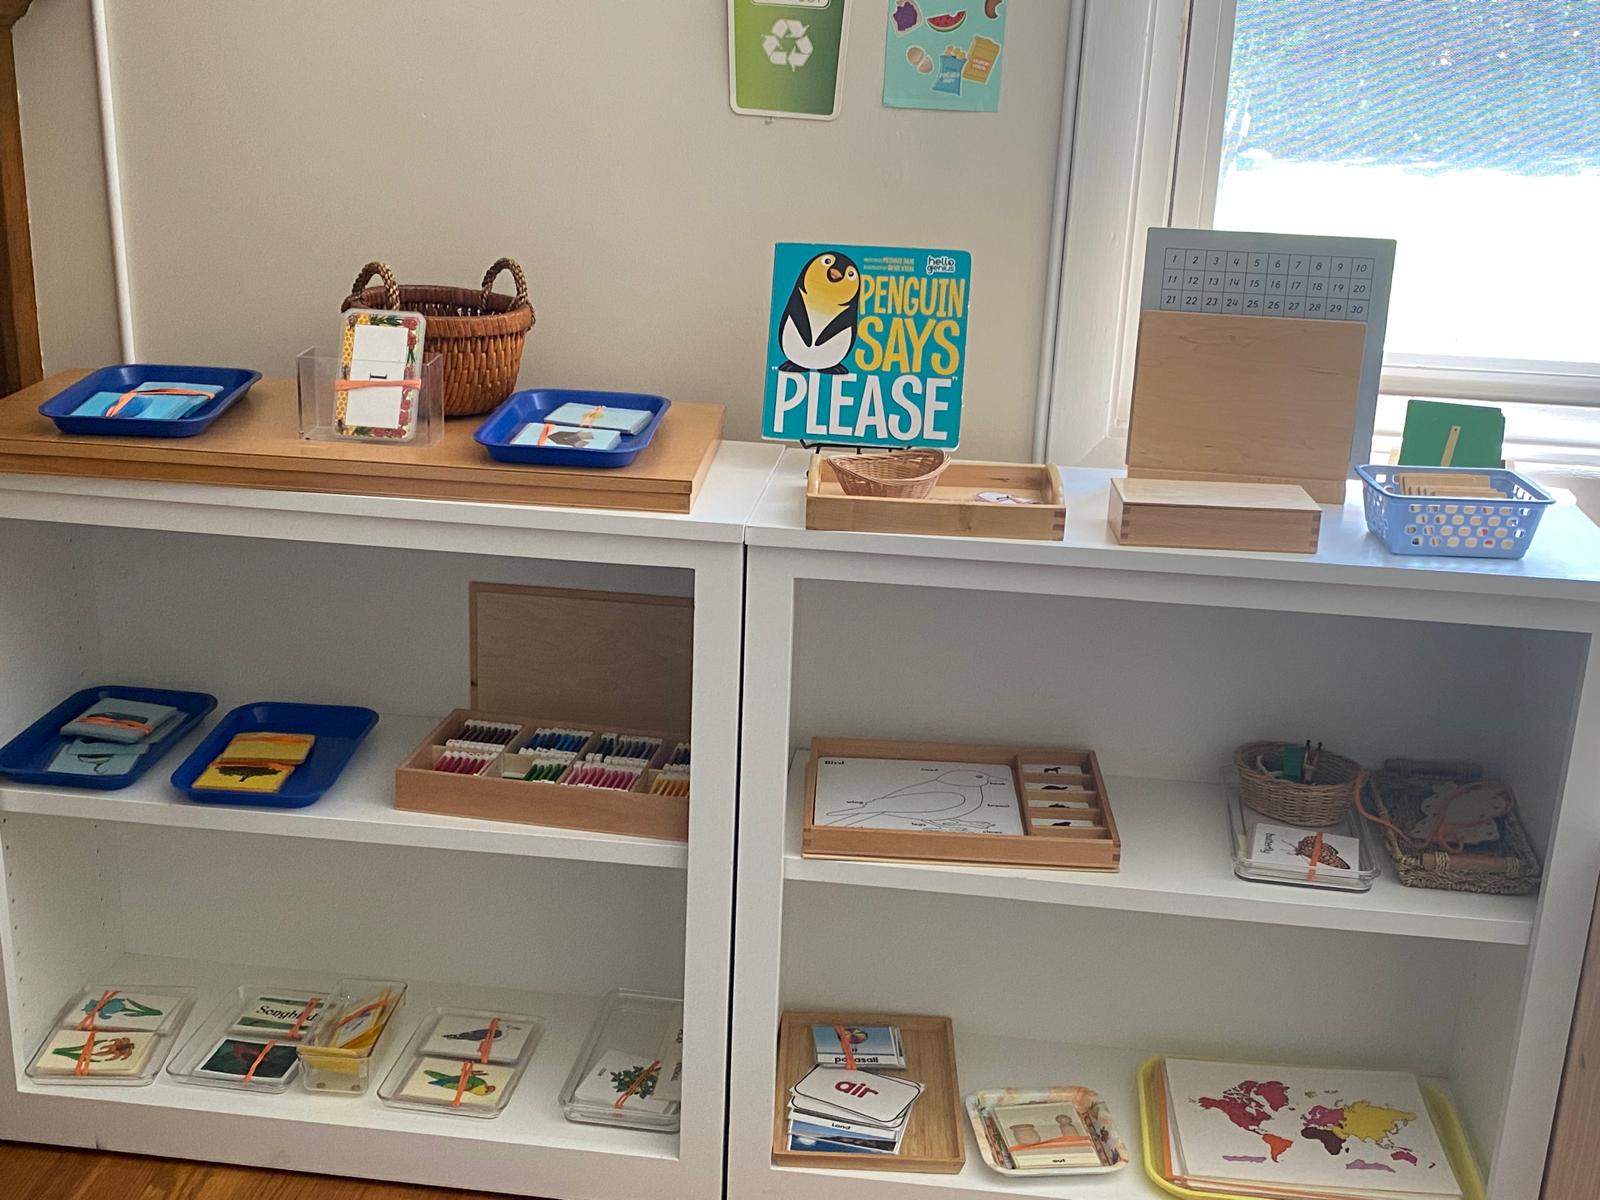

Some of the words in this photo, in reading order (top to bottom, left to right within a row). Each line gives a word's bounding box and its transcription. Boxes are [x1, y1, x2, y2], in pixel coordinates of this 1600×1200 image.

[926, 265, 954, 274] genius
[927, 256, 955, 266] hello
[1172, 255, 1177, 263] 1
[1192, 256, 1199, 264] 2
[1212, 256, 1220, 265] 3
[1233, 258, 1240, 266] 4
[1254, 259, 1261, 267] 5
[1274, 260, 1280, 268] 6
[1295, 261, 1302, 270] 7
[1316, 262, 1322, 270] 8
[1337, 263, 1344, 271] 9
[1356, 264, 1367, 272] 10
[1188, 276, 1199, 284] 12
[1208, 278, 1219, 286] 13
[1229, 278, 1240, 286] 14
[1250, 280, 1260, 288] 15
[1270, 280, 1280, 288] 16
[1290, 282, 1302, 290] 17
[1312, 282, 1322, 291] 18
[1332, 284, 1344, 292] 19
[1352, 284, 1366, 293] 20
[858, 275, 966, 318] PENGUIN
[1166, 295, 1176, 304] 21
[1186, 296, 1198, 305] 22
[1206, 298, 1218, 306] 23
[1226, 298, 1238, 307] 24
[1247, 300, 1258, 308] 25
[1267, 301, 1280, 310] 26
[1288, 302, 1300, 310] 27
[1308, 303, 1321, 312] 28
[1330, 304, 1342, 312] 29
[1350, 306, 1364, 314] 30
[854, 316, 960, 376] SAYS
[256, 1005, 319, 1021] Songbid
[834, 1056, 879, 1065] paasail
[834, 1080, 879, 1099] air
